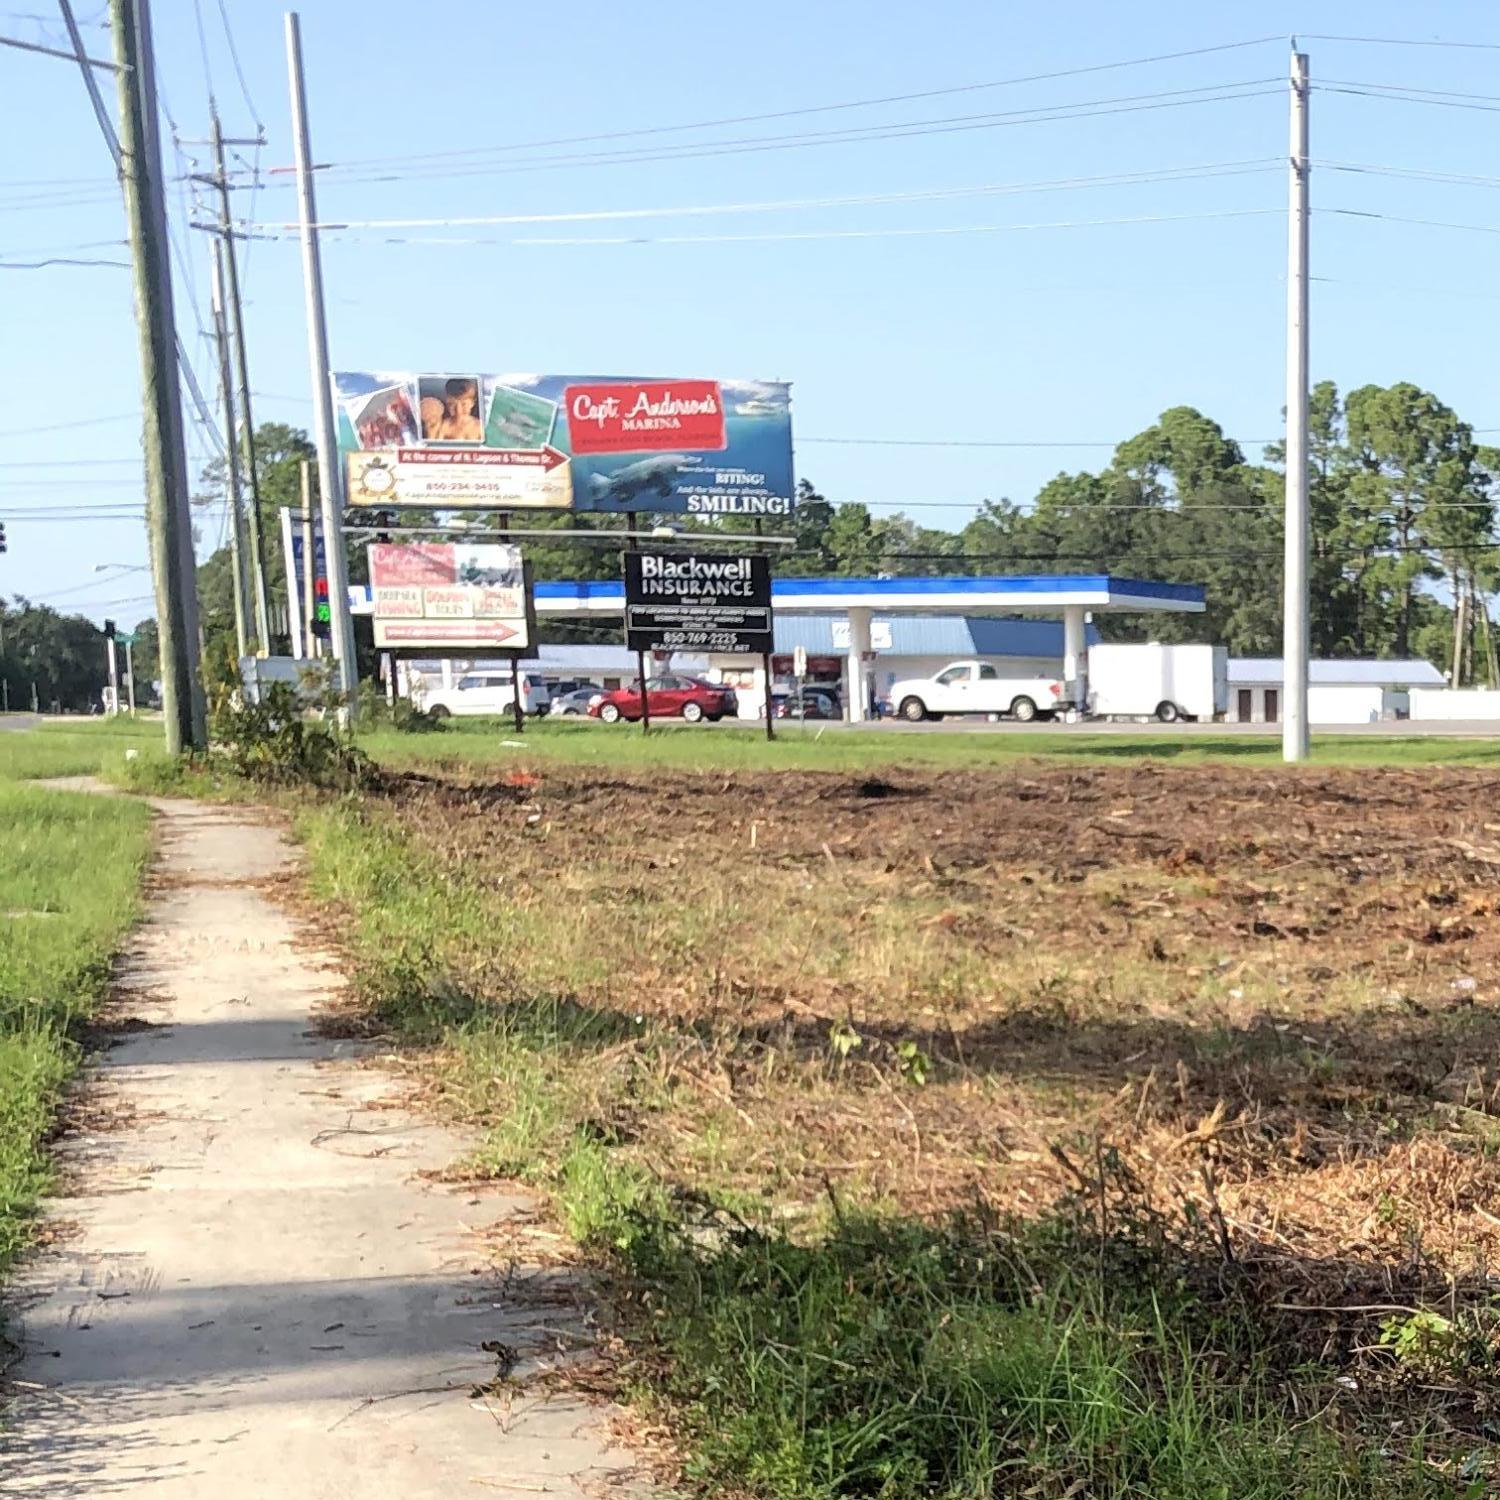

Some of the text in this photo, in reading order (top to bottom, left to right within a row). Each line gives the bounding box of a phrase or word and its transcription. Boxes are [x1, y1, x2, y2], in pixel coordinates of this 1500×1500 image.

[573, 391, 717, 429] Capt. Anderson's
[622, 417, 681, 431] MARINA
[715, 473, 765, 485] BITING!
[687, 495, 790, 514] SMILING!
[641, 556, 752, 580] Blackwell
[642, 579, 754, 597] INSURANCE
